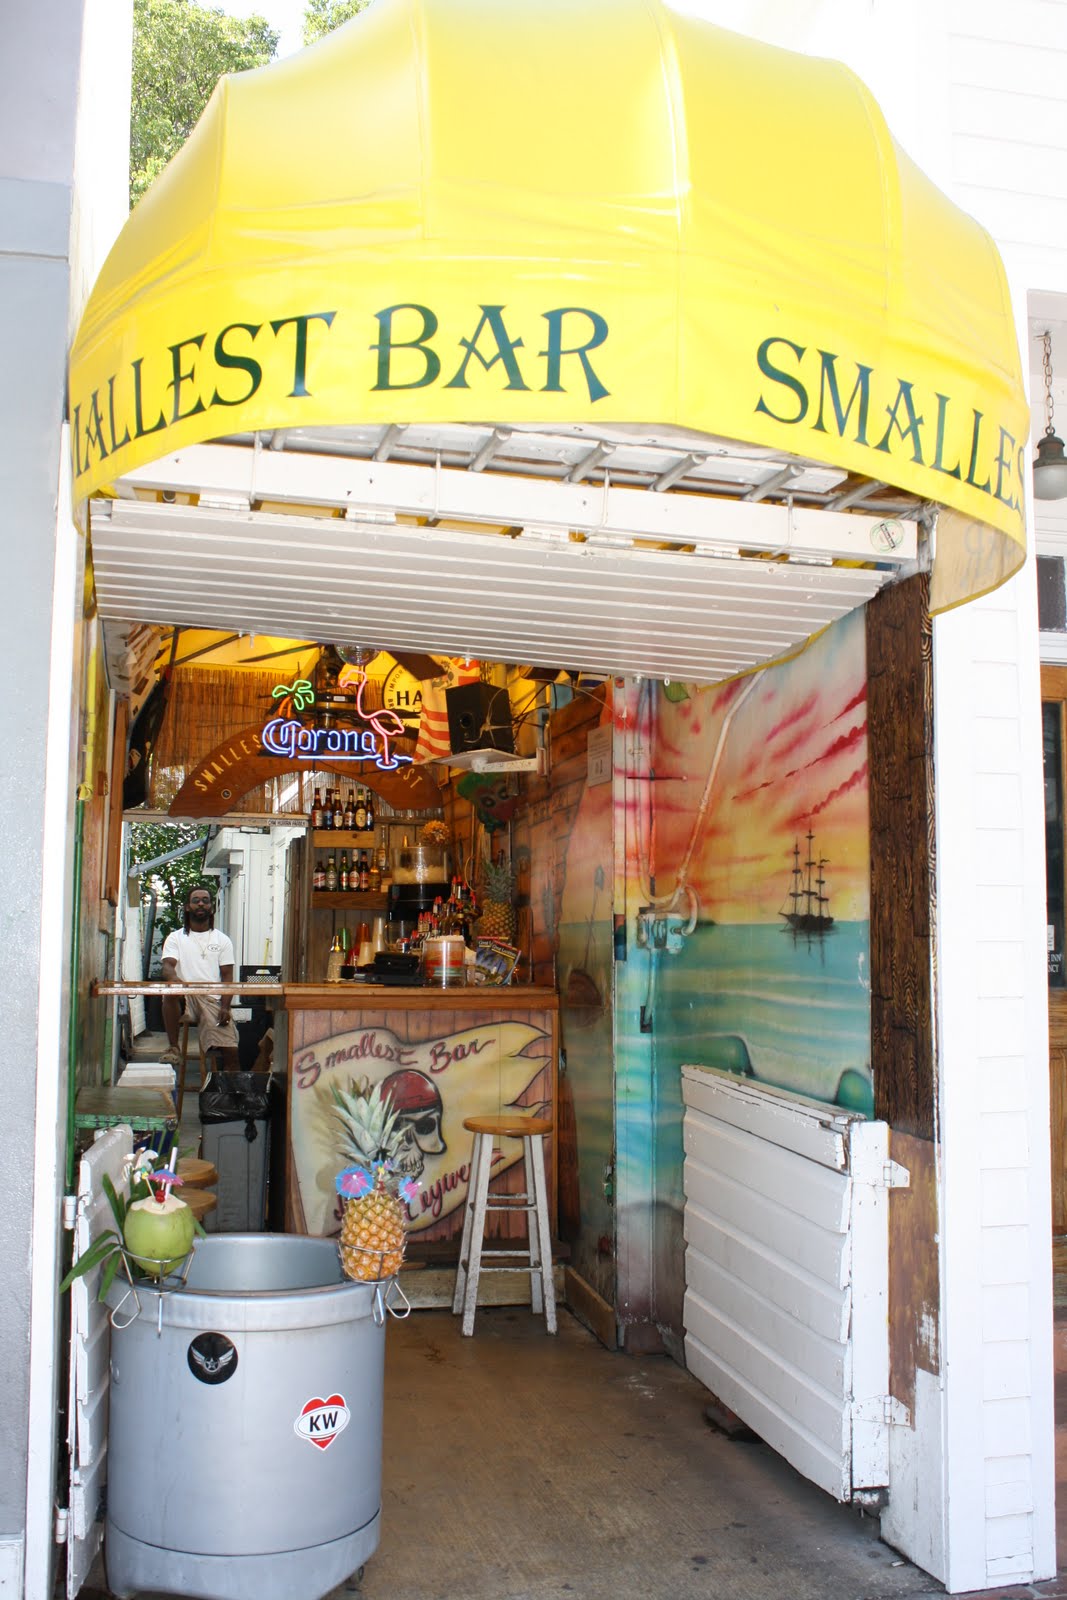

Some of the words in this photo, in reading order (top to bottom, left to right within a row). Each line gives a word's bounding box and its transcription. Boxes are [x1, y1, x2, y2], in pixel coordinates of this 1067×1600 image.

[369, 304, 610, 403] BAR
[262, 718, 376, 758] Corona
[194, 734, 267, 792] SMALLES
[429, 1038, 497, 1075] Bar
[310, 1411, 338, 1432] KW
